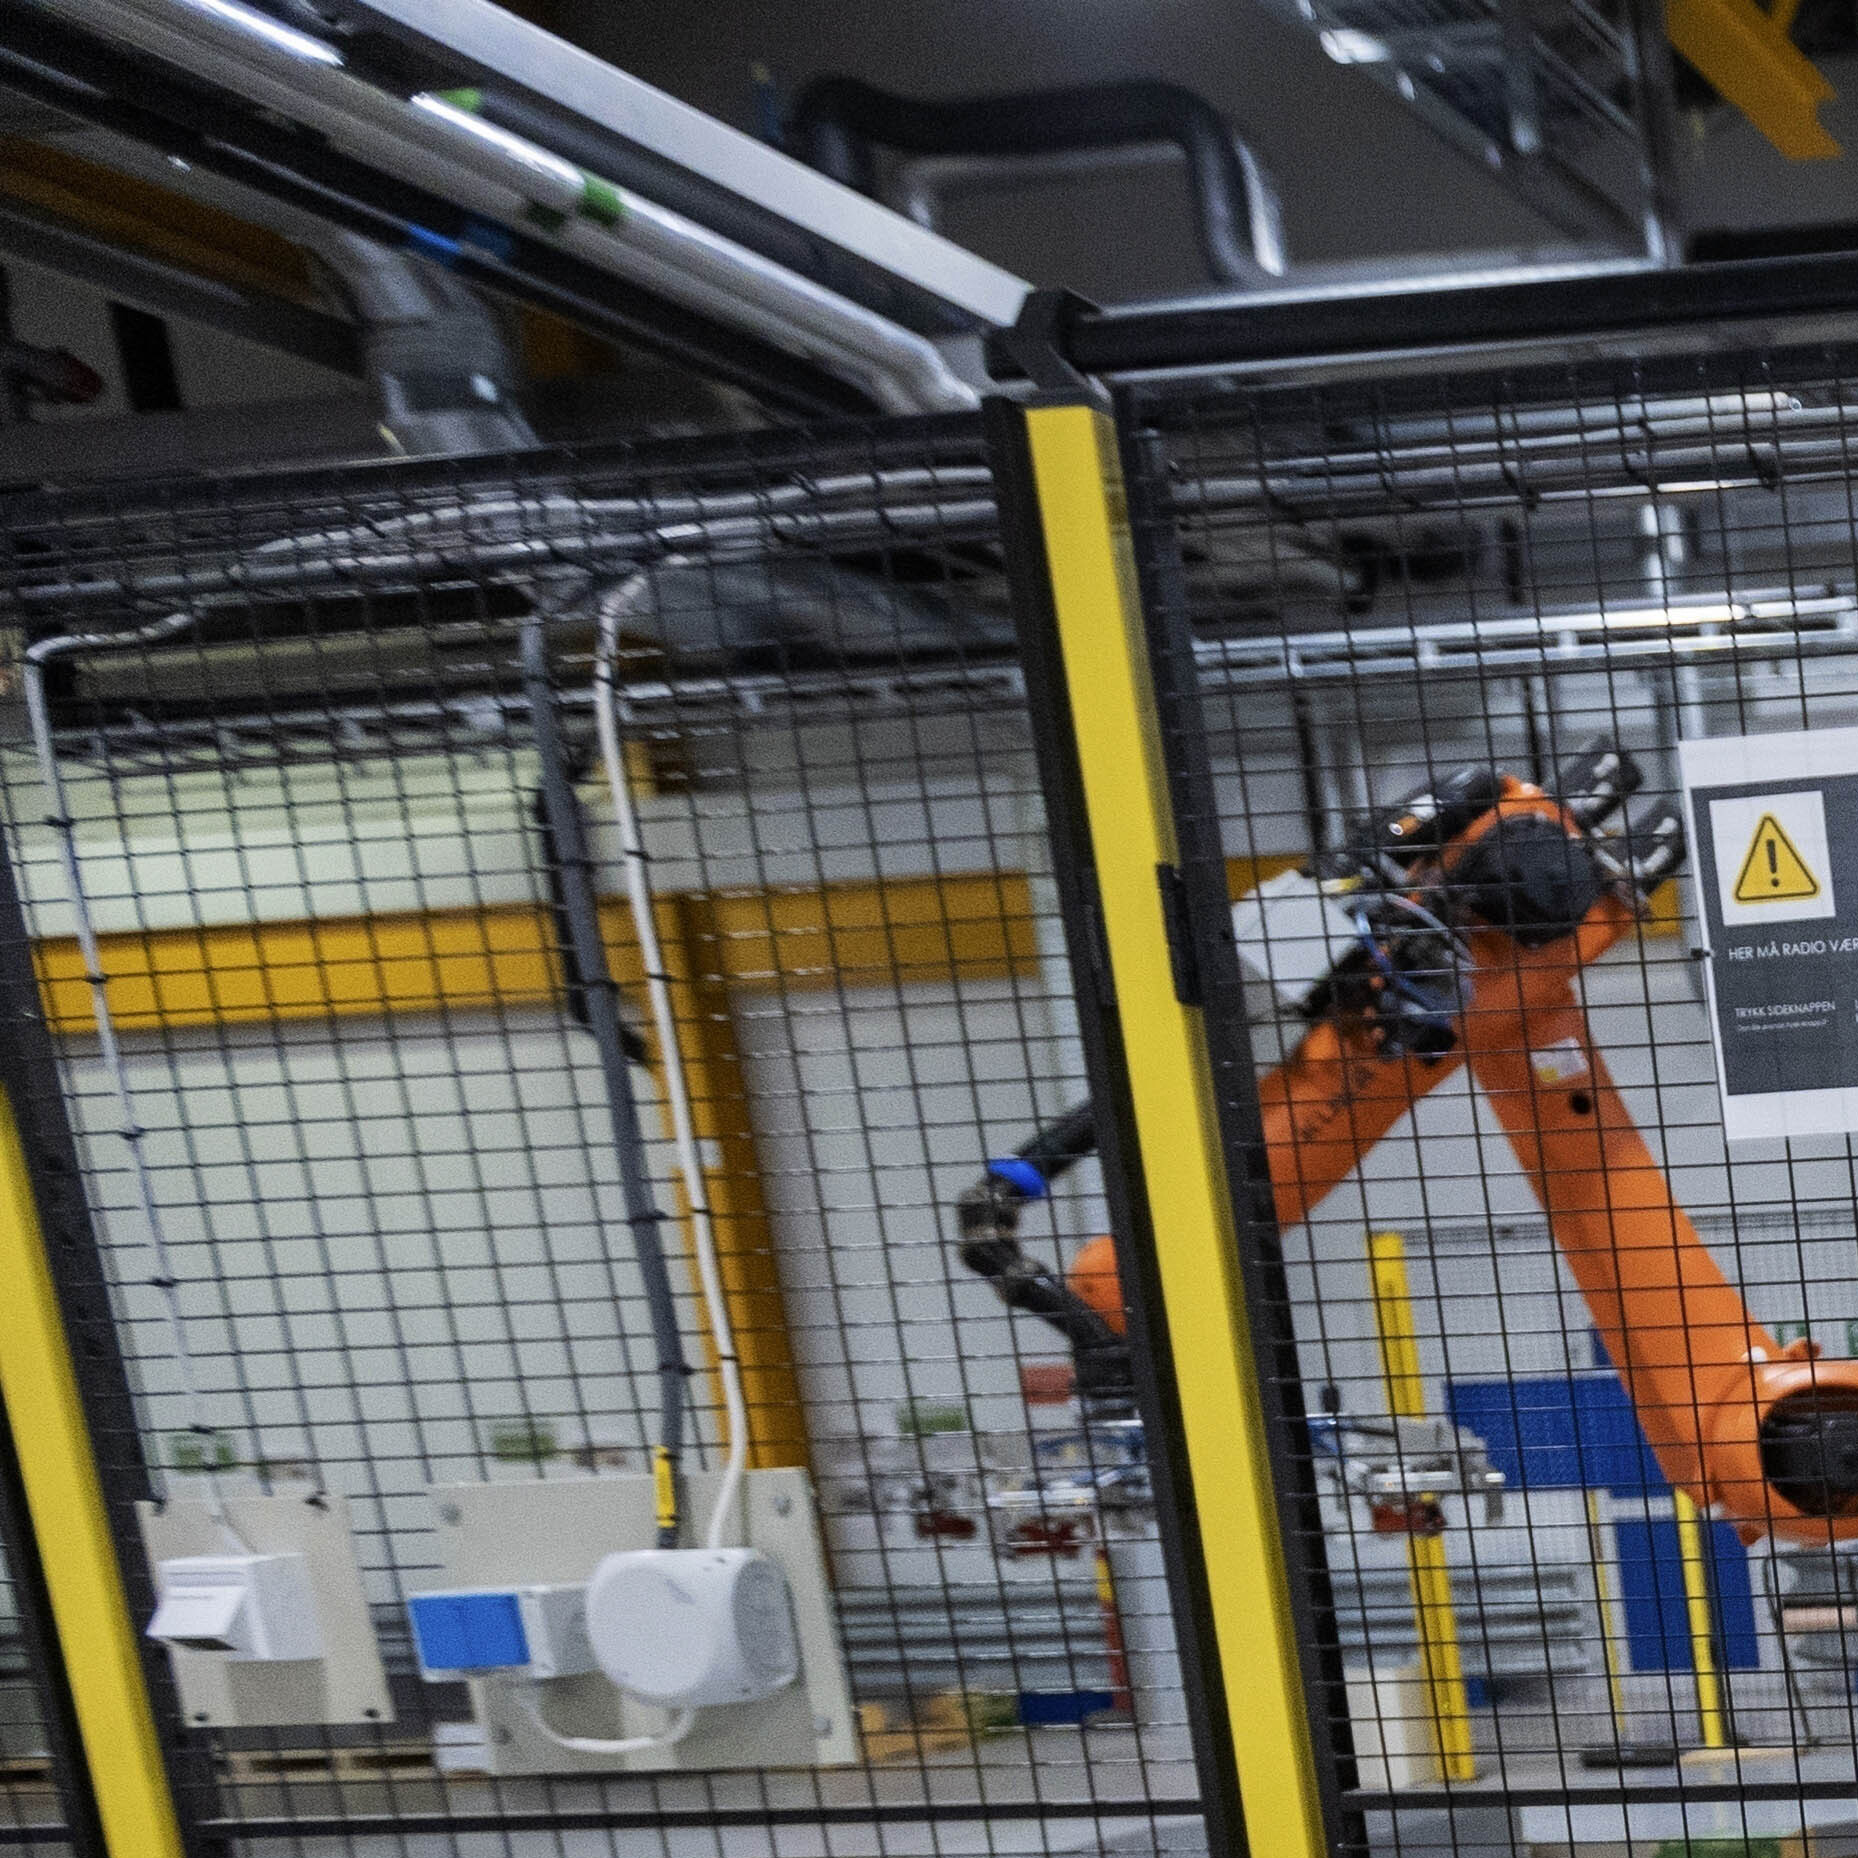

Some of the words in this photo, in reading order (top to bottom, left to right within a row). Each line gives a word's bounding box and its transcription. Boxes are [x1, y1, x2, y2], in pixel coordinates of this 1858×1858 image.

[1728, 946, 1754, 960] HER
[1757, 940, 1780, 958] MÅ
[1783, 942, 1826, 956] RADIO
[1734, 1005, 1768, 1018] TRYKK
